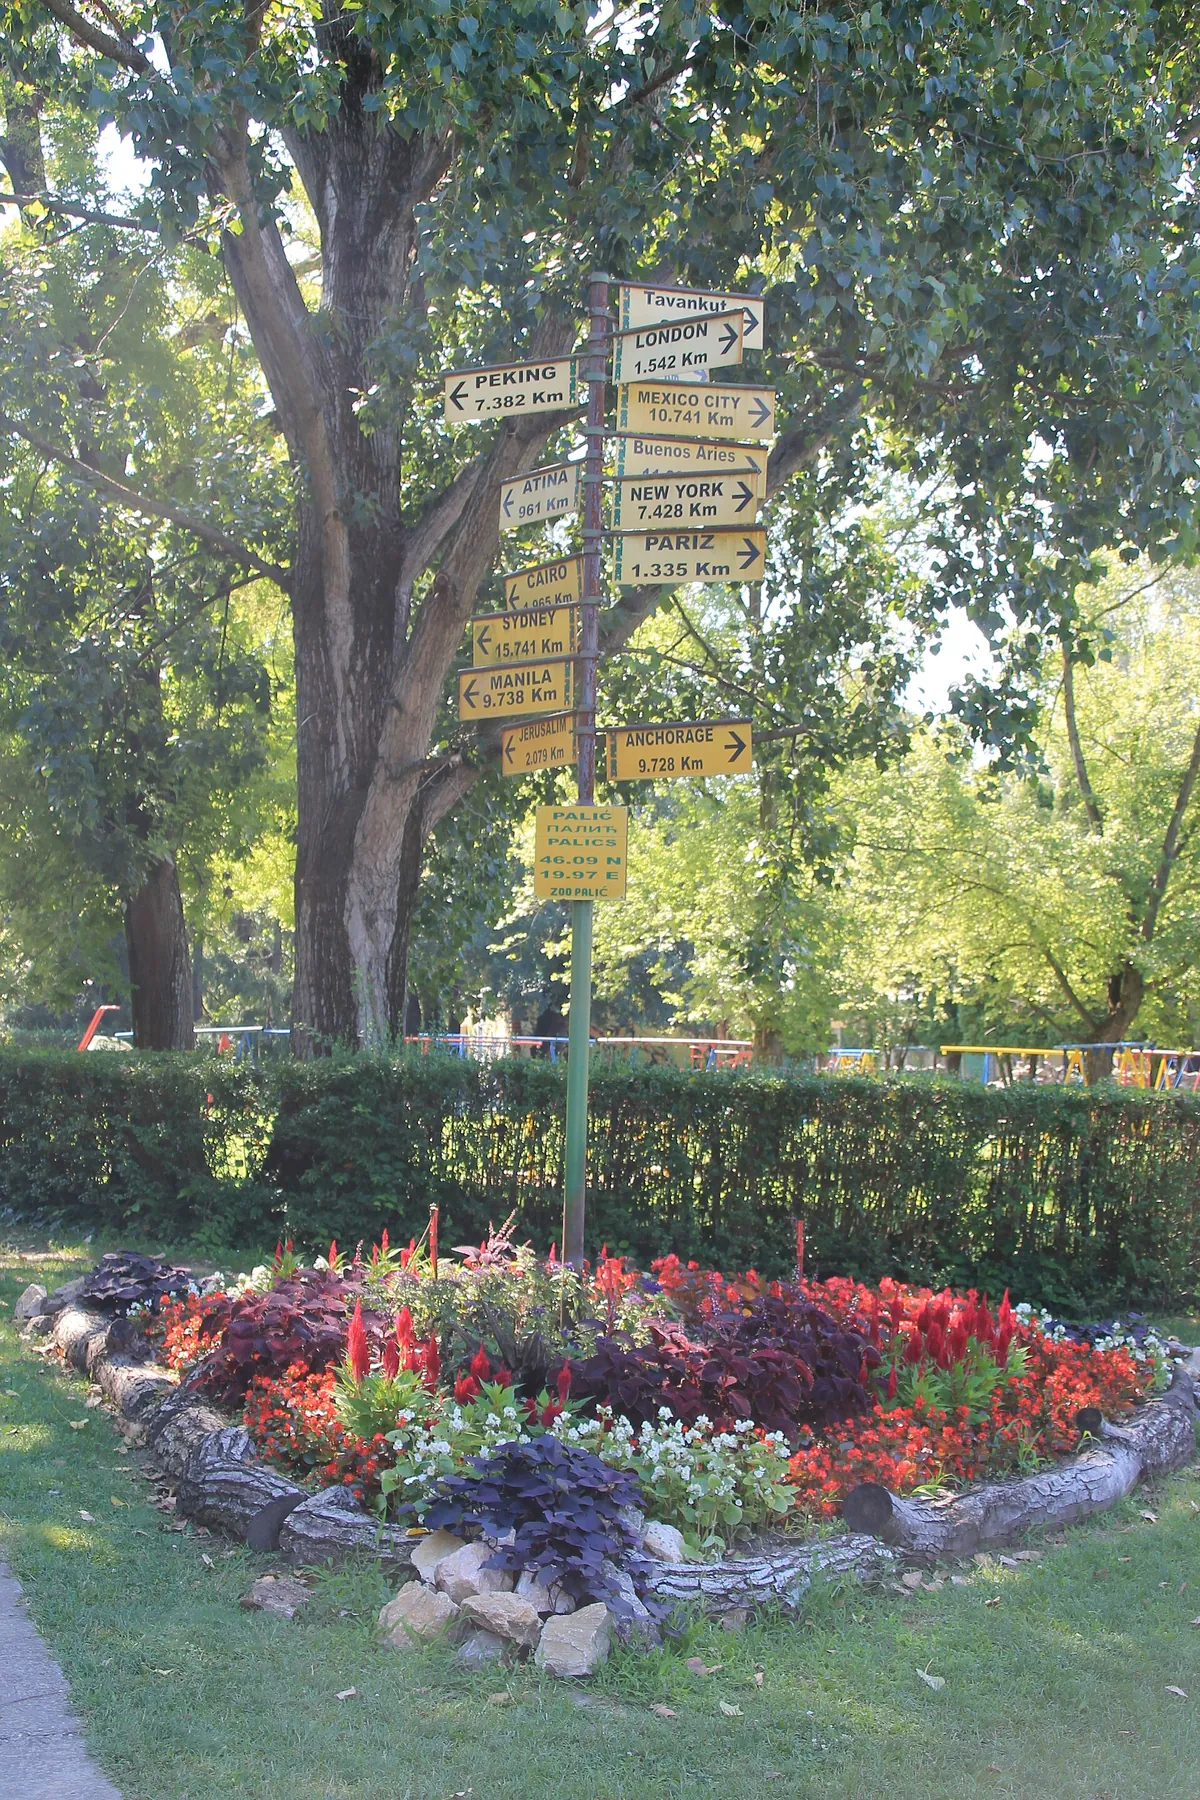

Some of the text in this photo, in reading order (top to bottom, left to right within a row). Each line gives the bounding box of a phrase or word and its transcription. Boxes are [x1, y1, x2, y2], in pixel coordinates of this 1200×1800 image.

[644, 291, 727, 312] Tavankut
[636, 322, 708, 349] LONDON
[635, 352, 708, 375] 1.542 Km
[475, 366, 556, 389] PEKING
[475, 391, 563, 412] 7.382 Km
[638, 391, 741, 409] MEXICO CITY
[649, 408, 734, 426] 10.741 Km
[633, 439, 736, 463] Buenos Aries
[522, 470, 568, 494] ATINA
[630, 482, 724, 501] NEW YORK
[518, 497, 569, 519] 961 Km
[638, 503, 717, 519] 7.428 Km
[645, 534, 715, 551] PARIZ
[527, 565, 568, 589] CAIRO
[631, 562, 730, 577] 1.335 Km
[554, 593, 573, 604] Km
[502, 610, 557, 630] SYDNEY
[495, 638, 563, 658] 15.741 Km
[490, 669, 552, 690] MANILA
[483, 688, 557, 708] 9.738 Km
[518, 719, 567, 742] JERUSALIM
[625, 728, 714, 747] ANCHORAGE
[525, 747, 565, 766] 2.079 Km
[638, 756, 703, 773] 9.728 Km
[552, 809, 613, 820] PALIĆ
[547, 838, 617, 847] PALICS
[539, 855, 621, 865] 46.09 N
[540, 870, 619, 880] 19.97 E
[550, 885, 608, 897] ZOO PALIĆ
